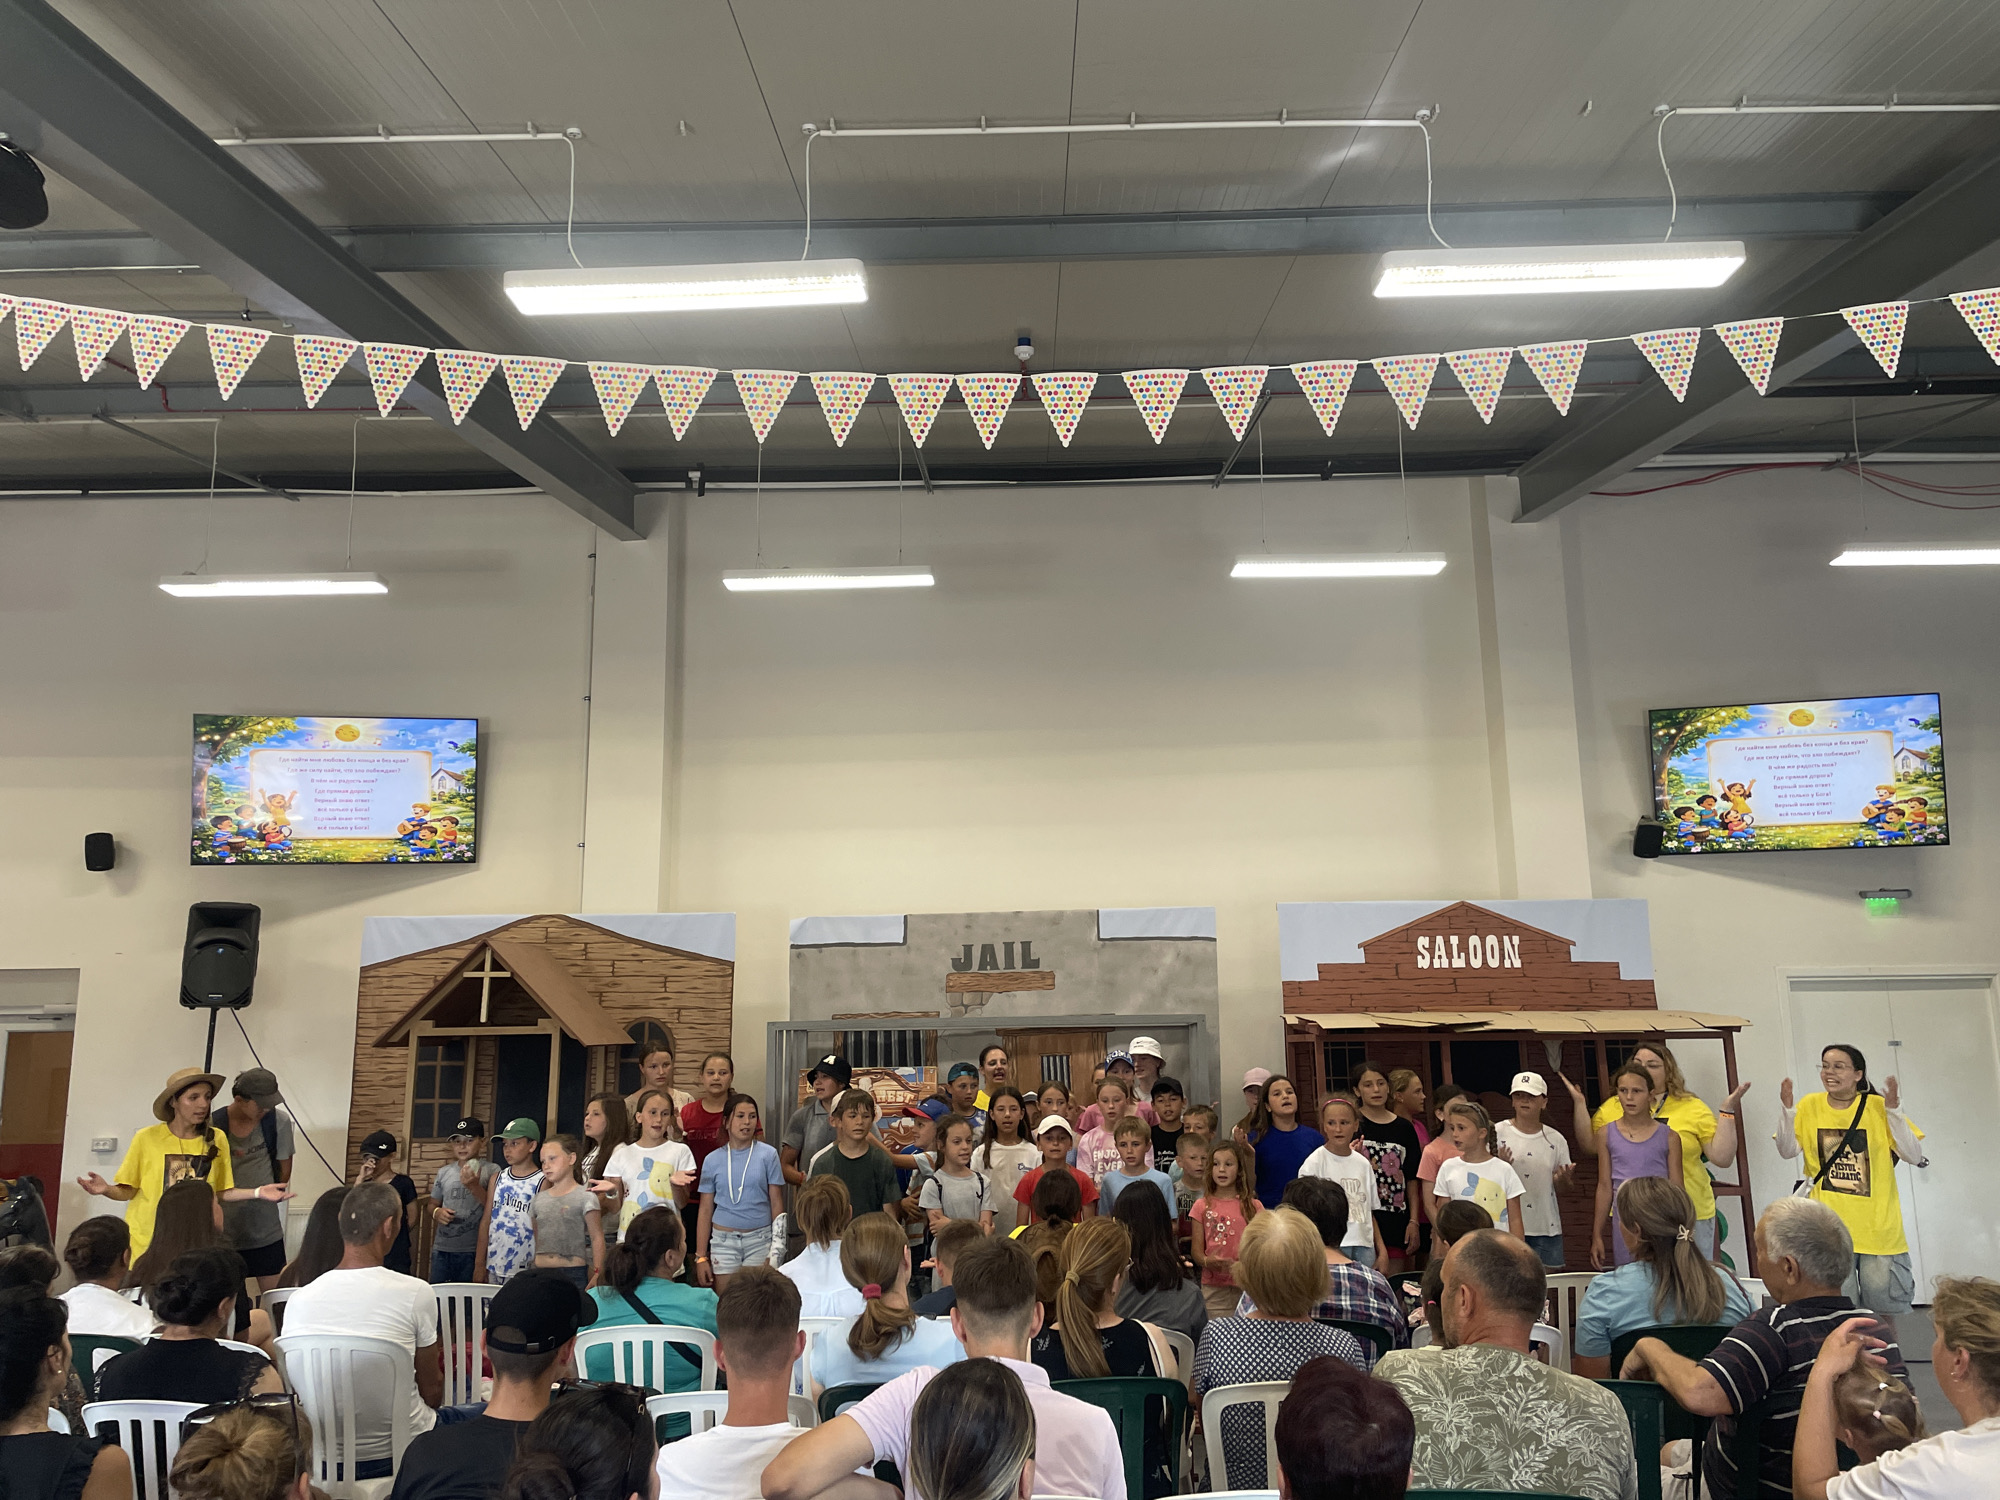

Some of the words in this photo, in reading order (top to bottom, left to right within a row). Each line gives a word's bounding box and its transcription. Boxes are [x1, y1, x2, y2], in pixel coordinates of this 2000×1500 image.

[950, 941, 1040, 972] JAIL
[1417, 934, 1522, 969] SALOON
[245, 1141, 267, 1155] JONE
[502, 1193, 531, 1213] Angel
[1178, 1197, 1194, 1209] Kar
